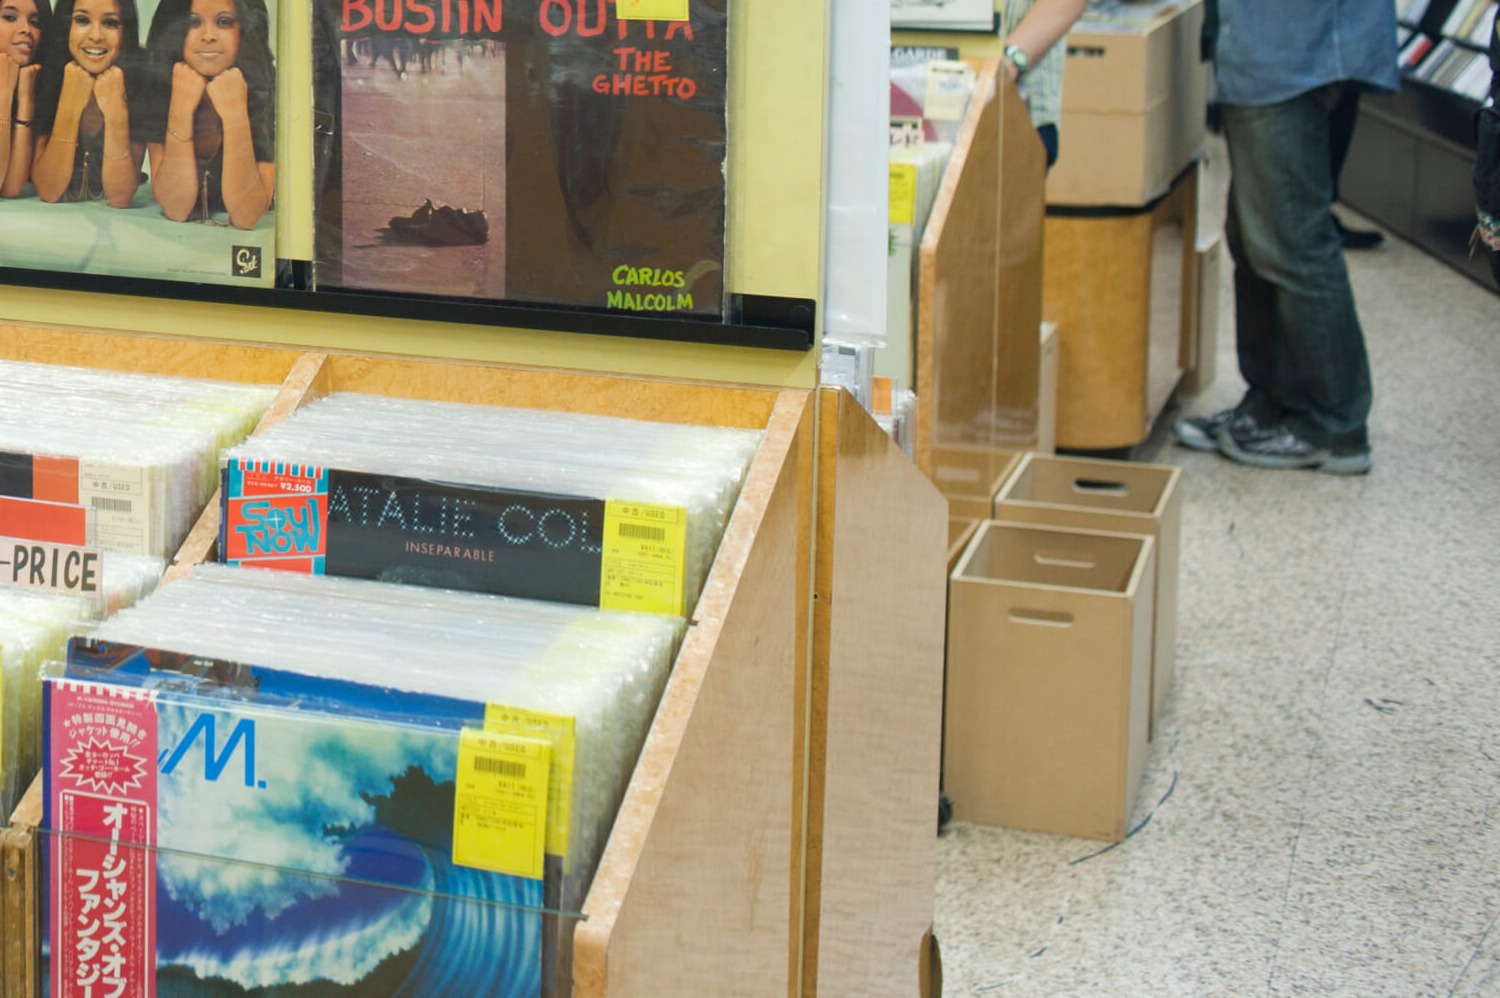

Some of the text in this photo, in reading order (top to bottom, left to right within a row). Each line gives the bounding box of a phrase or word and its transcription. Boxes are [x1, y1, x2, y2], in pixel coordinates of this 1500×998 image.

[613, 47, 673, 73] THE
[592, 74, 697, 99] GHETTO
[612, 264, 685, 288] CARLOS
[607, 289, 694, 312] MALCOLM
[404, 539, 496, 563] INSEPARABLE
[101, 801, 129, 998] オーシャンズ・オブ
[75, 868, 101, 998] ファンタジー
